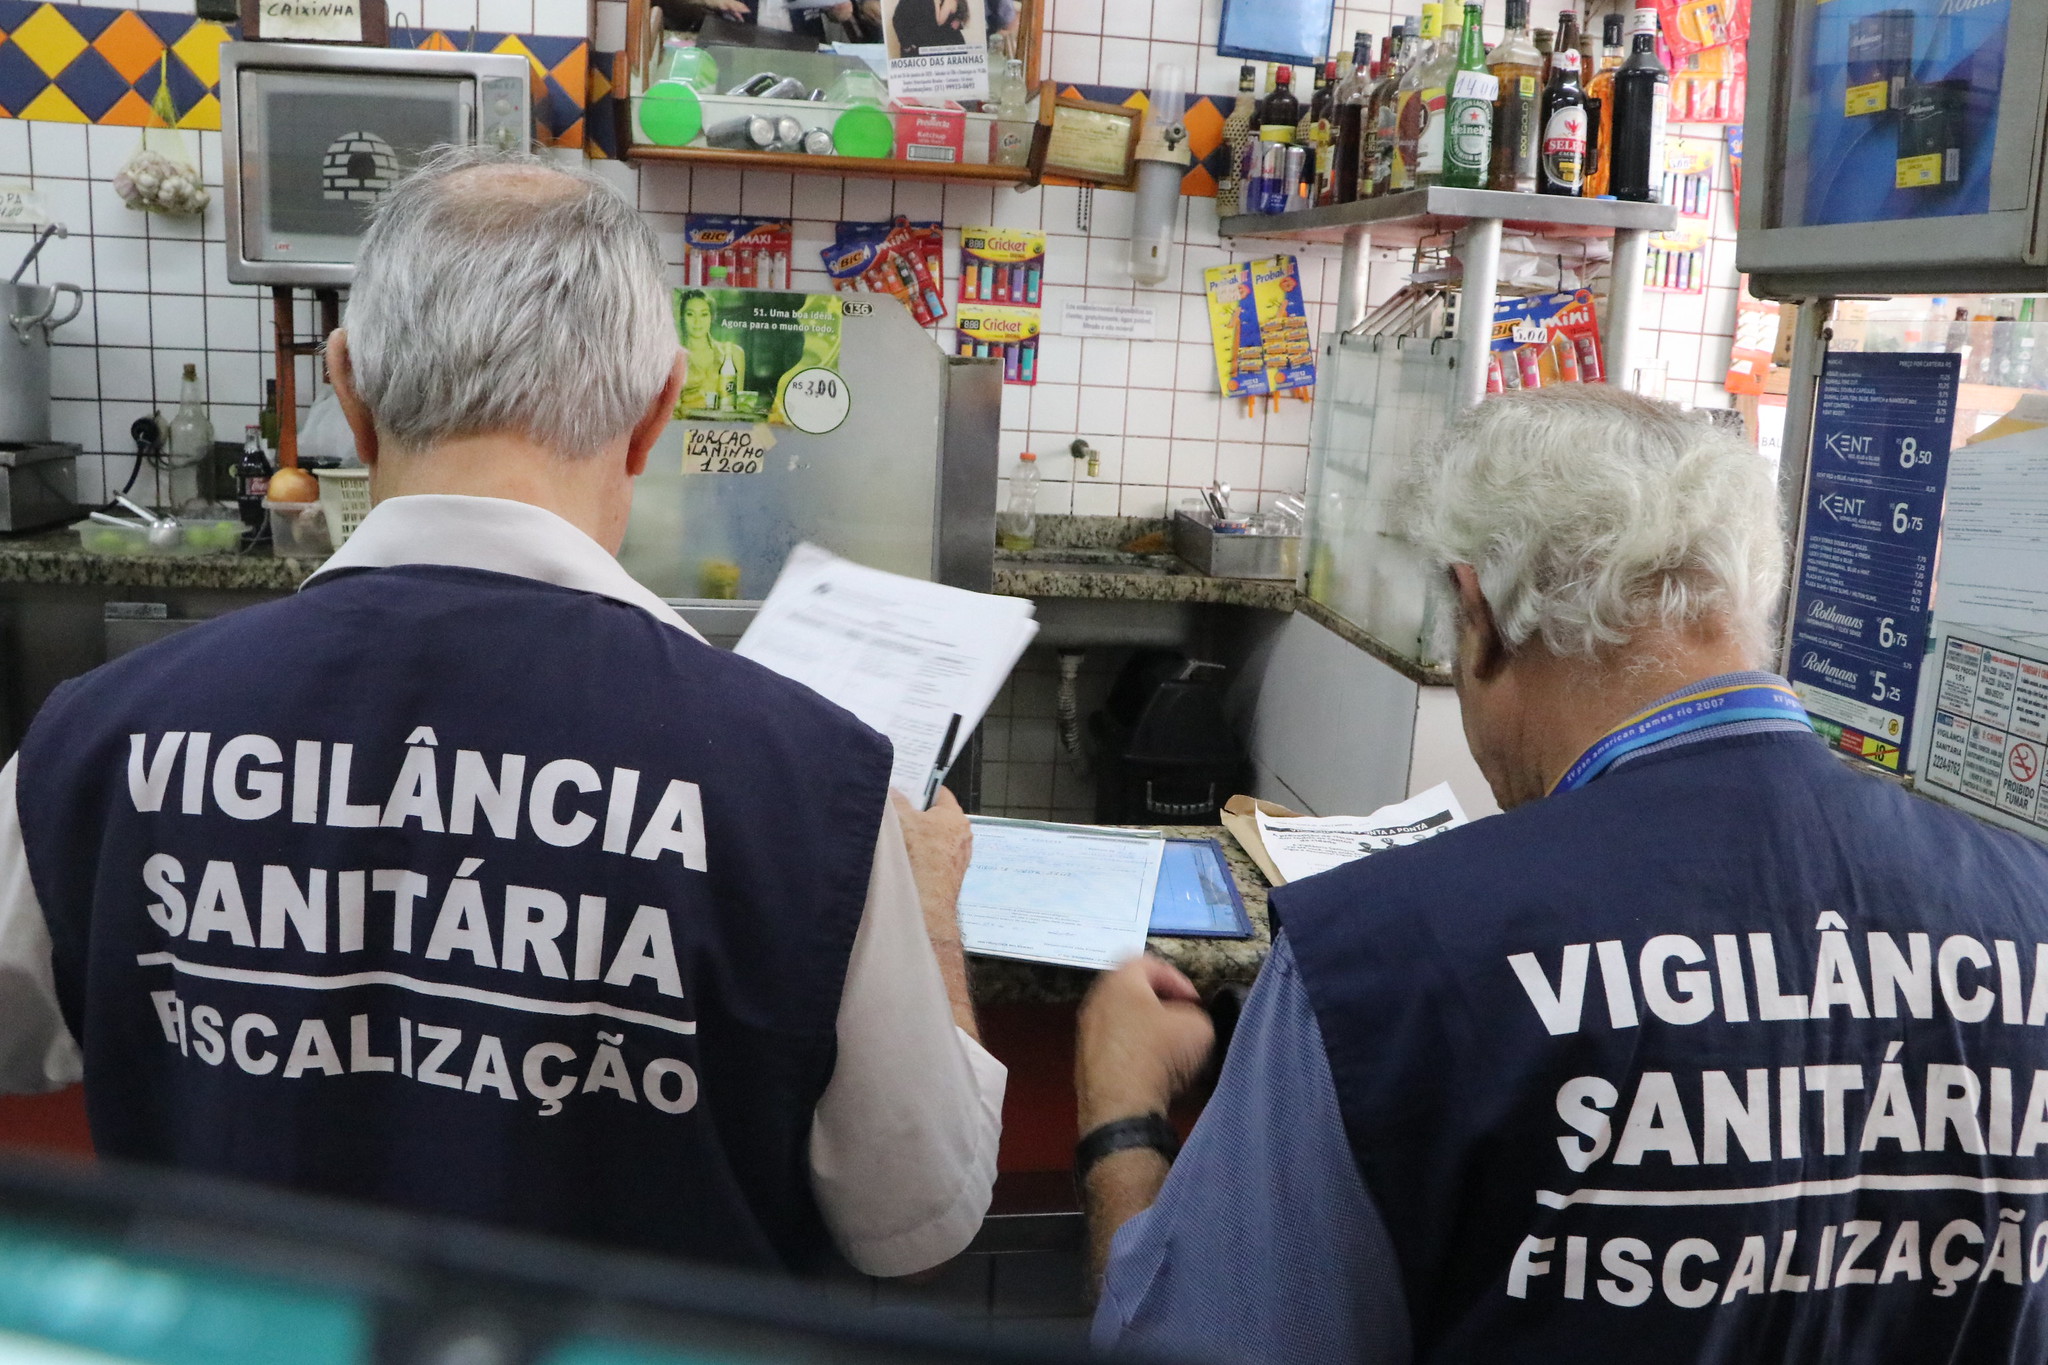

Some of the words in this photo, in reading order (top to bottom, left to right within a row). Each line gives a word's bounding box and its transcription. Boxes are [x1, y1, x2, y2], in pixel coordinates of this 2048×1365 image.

[891, 58, 927, 69] MOSAICO
[930, 57, 945, 67] DAS
[947, 55, 984, 66] ARANHAS
[917, 131, 947, 140] Ketchup
[701, 231, 725, 241] BIC
[740, 235, 771, 244] MAXI
[988, 237, 1027, 252] Cricket
[841, 252, 862, 268] BIC
[1256, 268, 1285, 285] Probak
[753, 307, 767, 317] 51.
[770, 309, 790, 318] Uma
[791, 309, 808, 319] boa
[847, 303, 869, 315] 136
[721, 318, 748, 329] Agora
[749, 321, 770, 331] para
[779, 322, 809, 332] mundo
[811, 324, 834, 334] todo.
[983, 318, 1022, 332] Cricket
[1516, 329, 1546, 342] 5.00
[1824, 430, 1873, 463] KENT
[1899, 437, 1932, 469] 8,50
[1818, 491, 1866, 523] KENT
[1892, 502, 1923, 534] 6,75
[1807, 599, 1864, 630] Rothmans
[1879, 617, 1908, 648] 6,75
[1801, 651, 1859, 683] Rothmans
[1871, 671, 1901, 702] 5,25
[1575, 757, 1591, 776] pan
[1592, 728, 1635, 759] american
[1638, 712, 1674, 734] games
[1676, 707, 1692, 717] rio
[1695, 697, 1725, 711] 2007
[1937, 728, 1965, 743] VIGILÂNCIA
[1987, 732, 2003, 745] CRIME
[2003, 779, 2035, 800] PROIBIDO
[127, 726, 708, 873] VIGILÂNCIA
[2005, 792, 2029, 811] FUMAR
[1389, 827, 1395, 836] A
[1396, 822, 1429, 834] PONTA
[142, 853, 685, 999] SANITÁRIA
[150, 990, 699, 1116] FISCALIZAÇÃO
